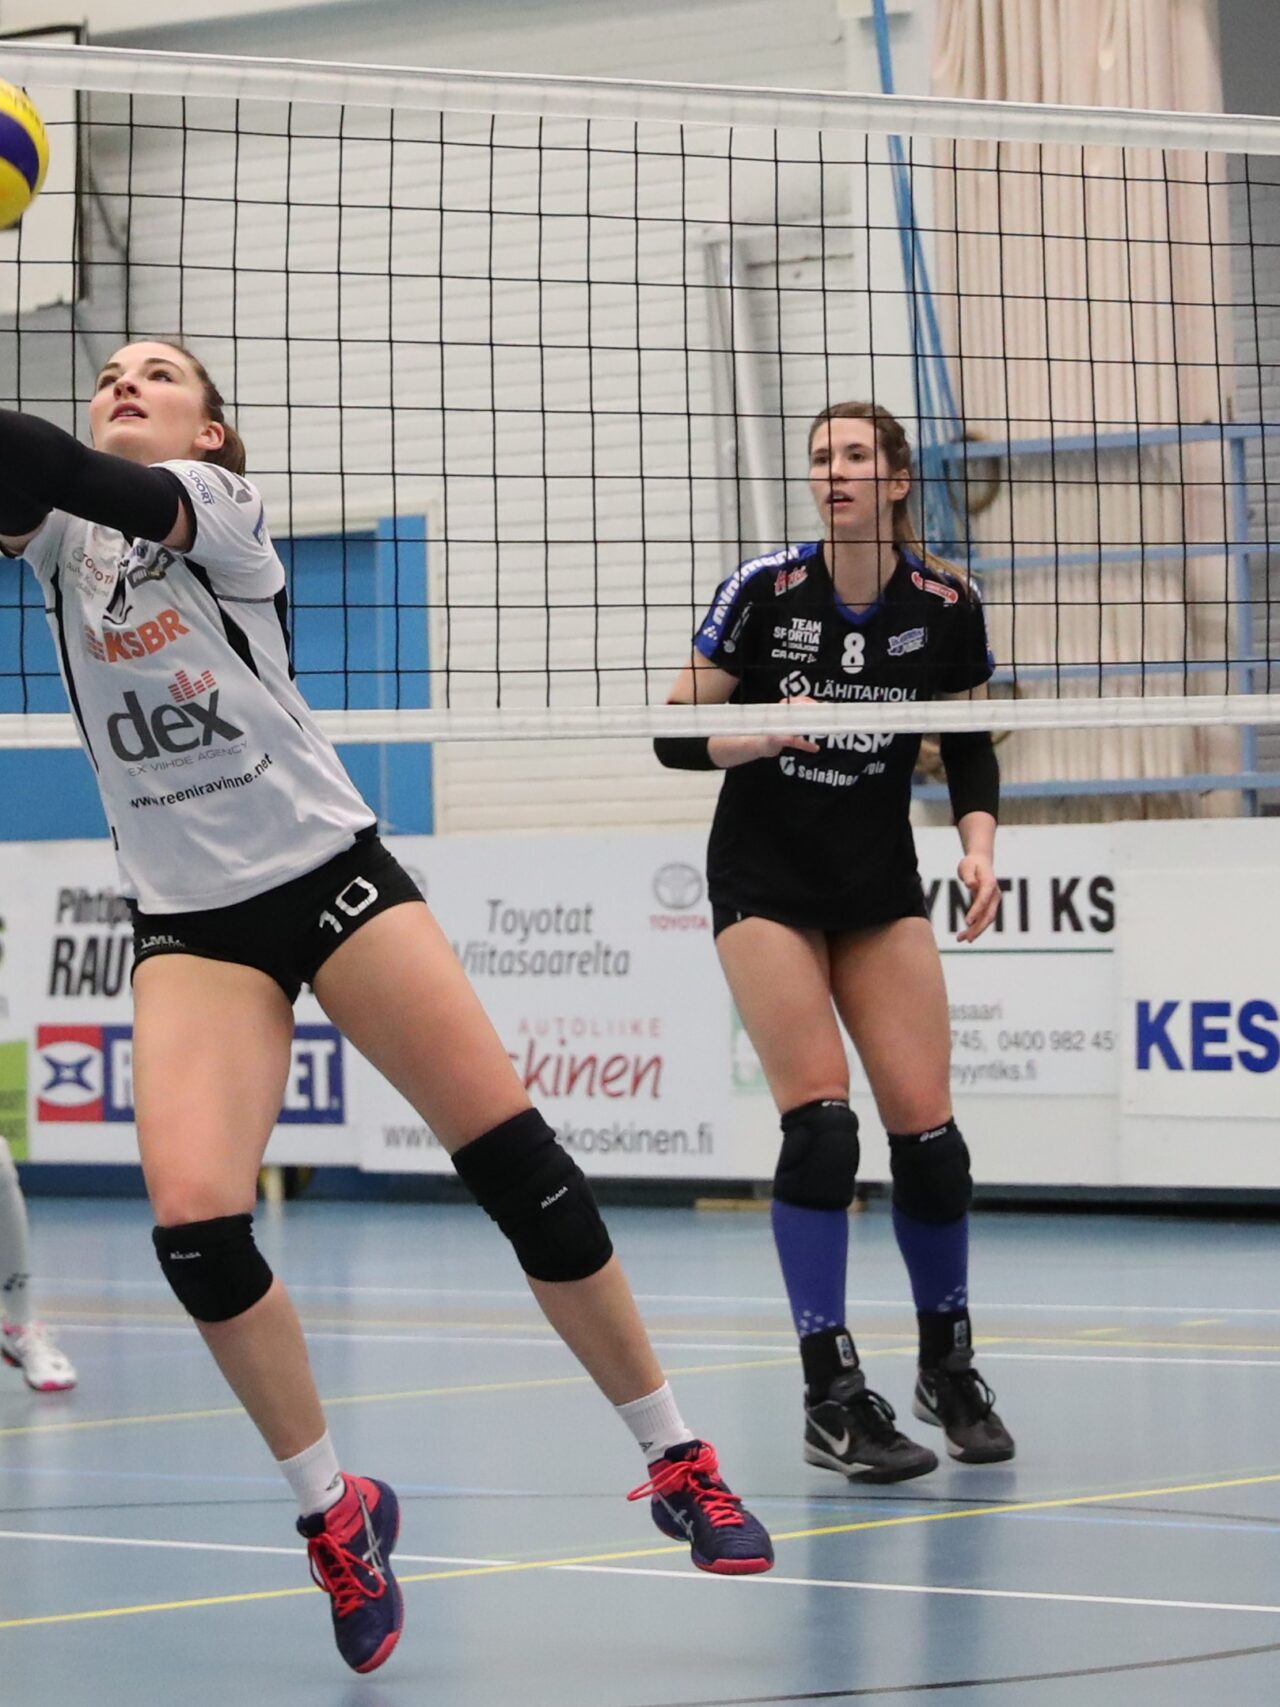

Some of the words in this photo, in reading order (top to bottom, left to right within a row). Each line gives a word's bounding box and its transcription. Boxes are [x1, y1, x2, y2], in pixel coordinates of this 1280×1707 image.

[187, 469, 213, 505] SPORT
[792, 618, 821, 632] TEAM
[771, 649, 807, 662] CRAFT
[841, 633, 865, 674] 8
[107, 688, 244, 762] dex
[198, 740, 248, 761] AGENCY
[487, 899, 593, 944] Toyotat
[649, 914, 709, 931] TOYOTA
[1051, 875, 1115, 933] KS
[48, 936, 134, 997] RAU
[518, 1016, 662, 1038] AUTOLIIKE
[997, 1029, 1046, 1051] 0400
[1048, 1029, 1086, 1051] 982
[1090, 1029, 1118, 1051] 45
[1135, 1000, 1280, 1073] KES
[508, 1037, 665, 1099] kinen
